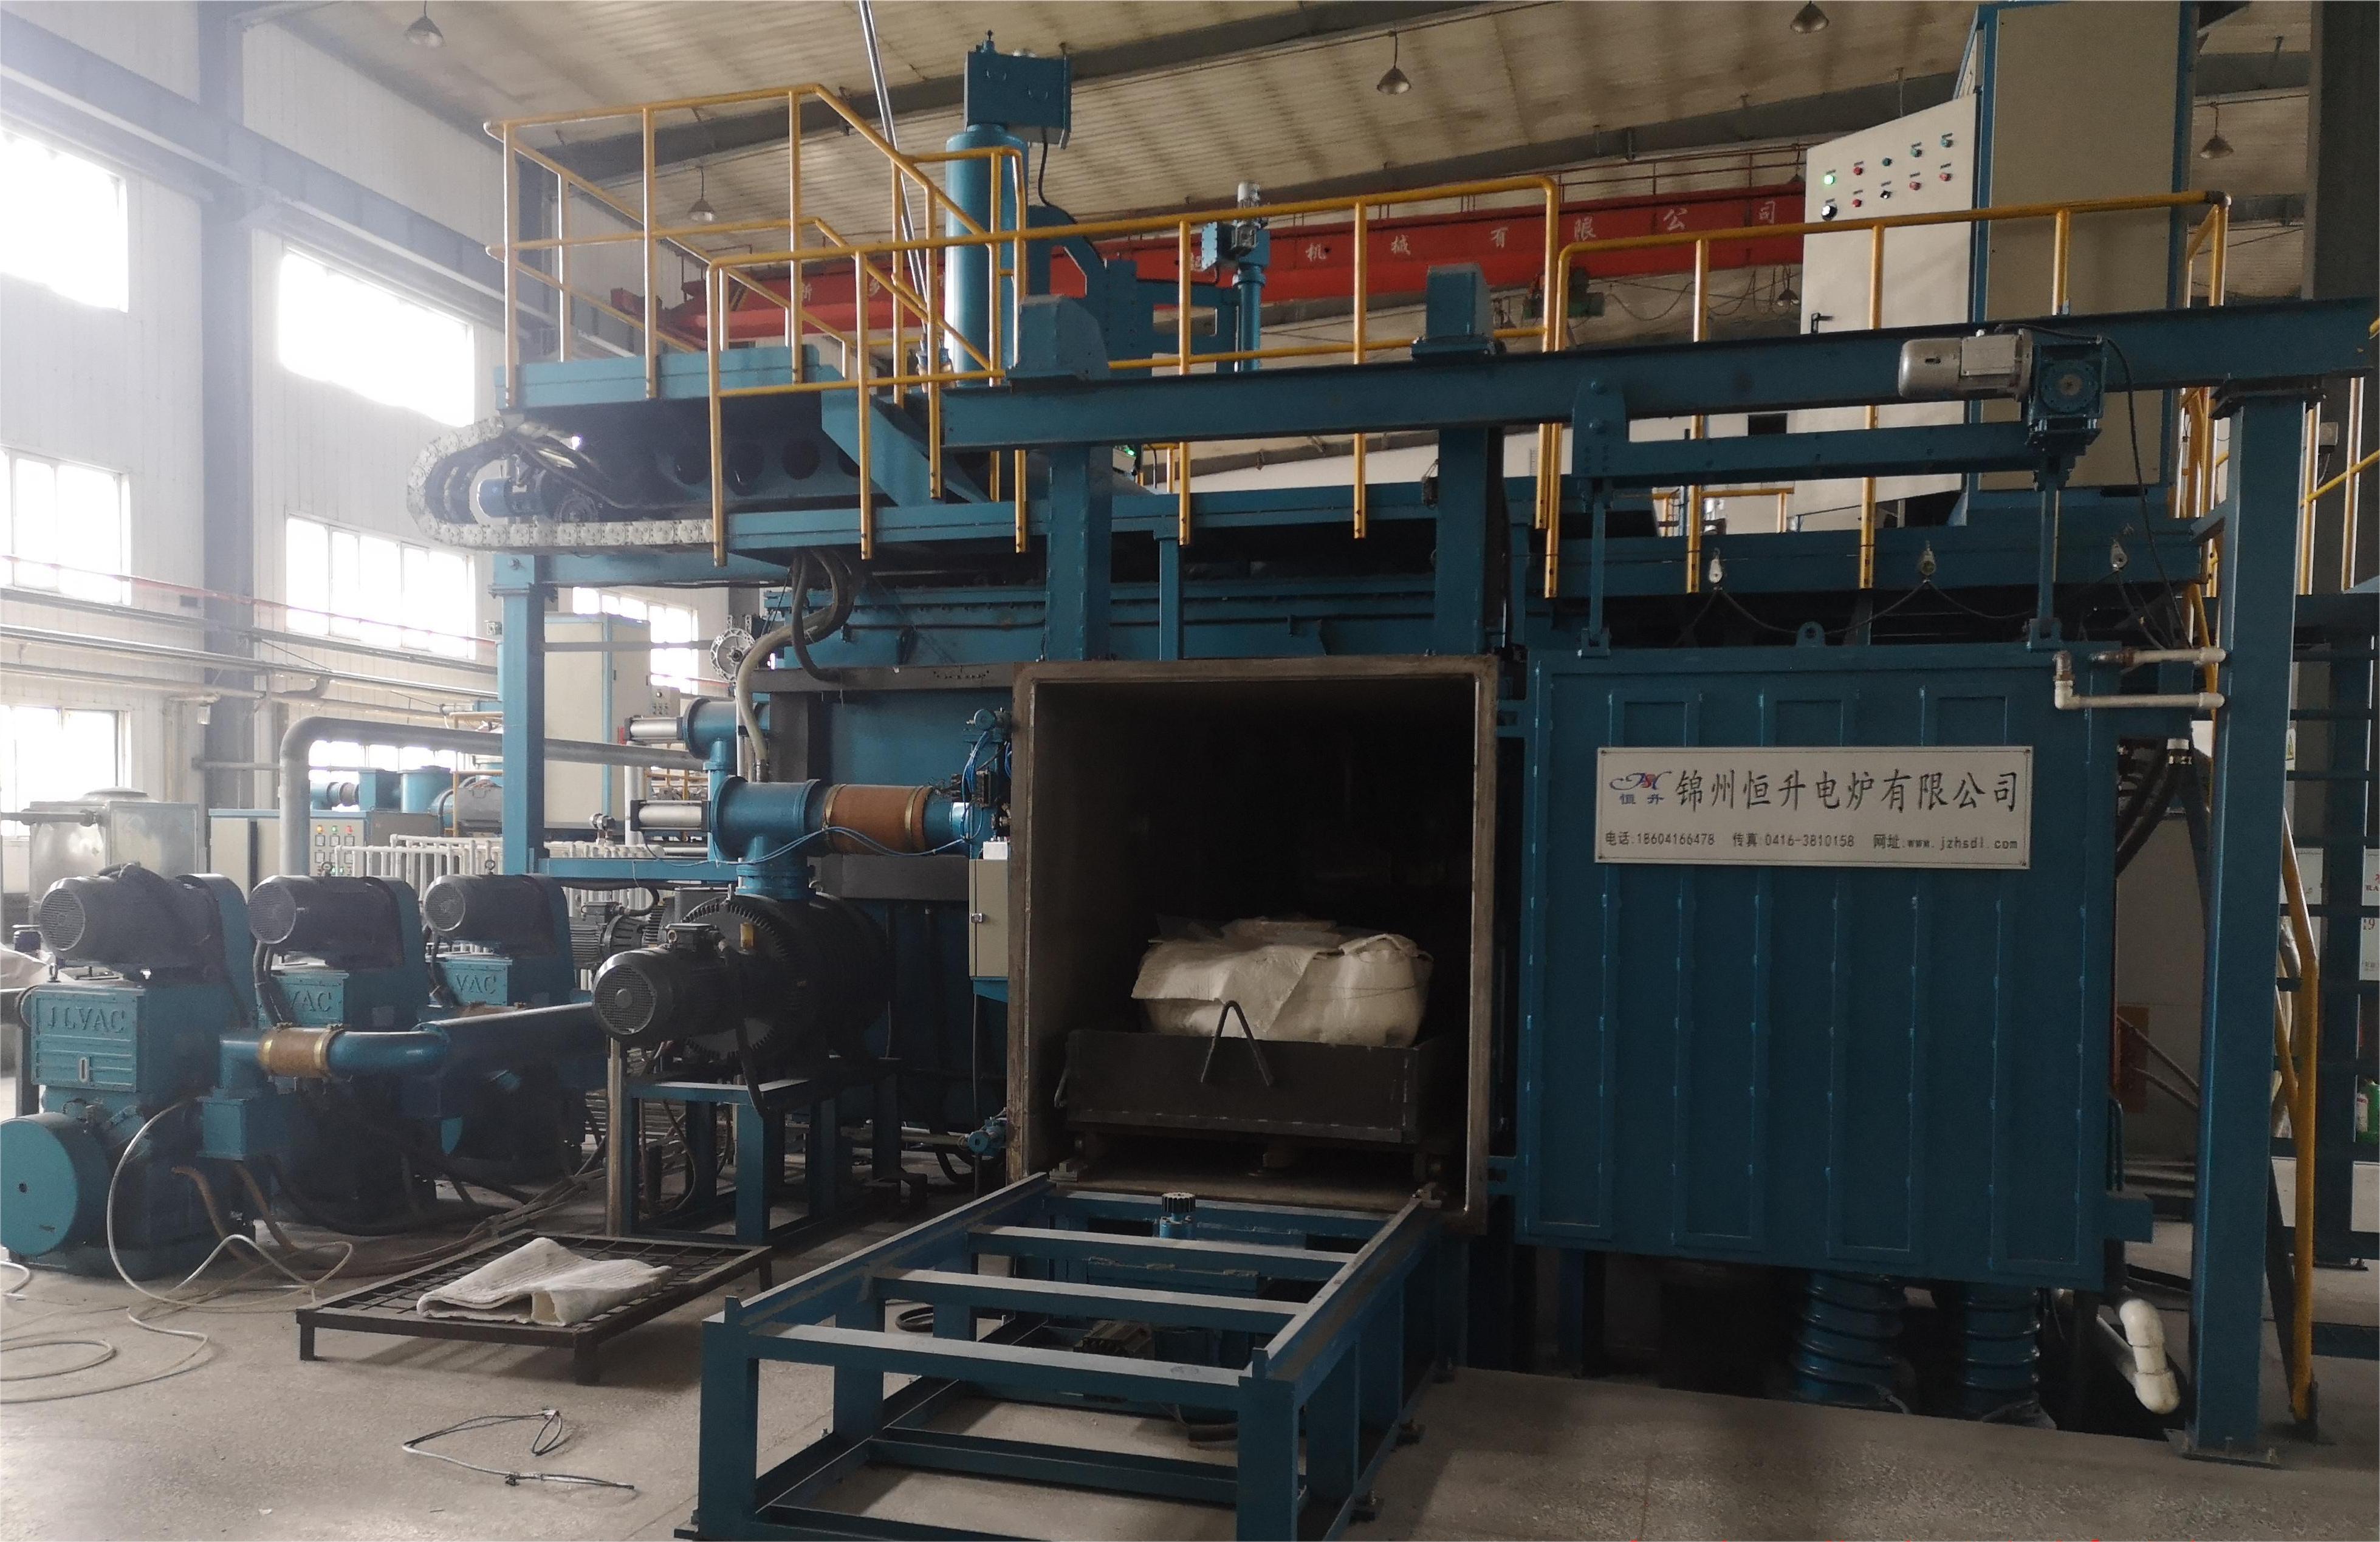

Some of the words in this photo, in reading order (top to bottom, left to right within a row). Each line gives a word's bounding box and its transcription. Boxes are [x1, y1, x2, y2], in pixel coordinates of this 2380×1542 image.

[1619, 793, 1665, 806] 恒升
[1675, 769, 2018, 812] 锦州恒升电炉有限公司
[47, 1006, 126, 1033] JLVAC
